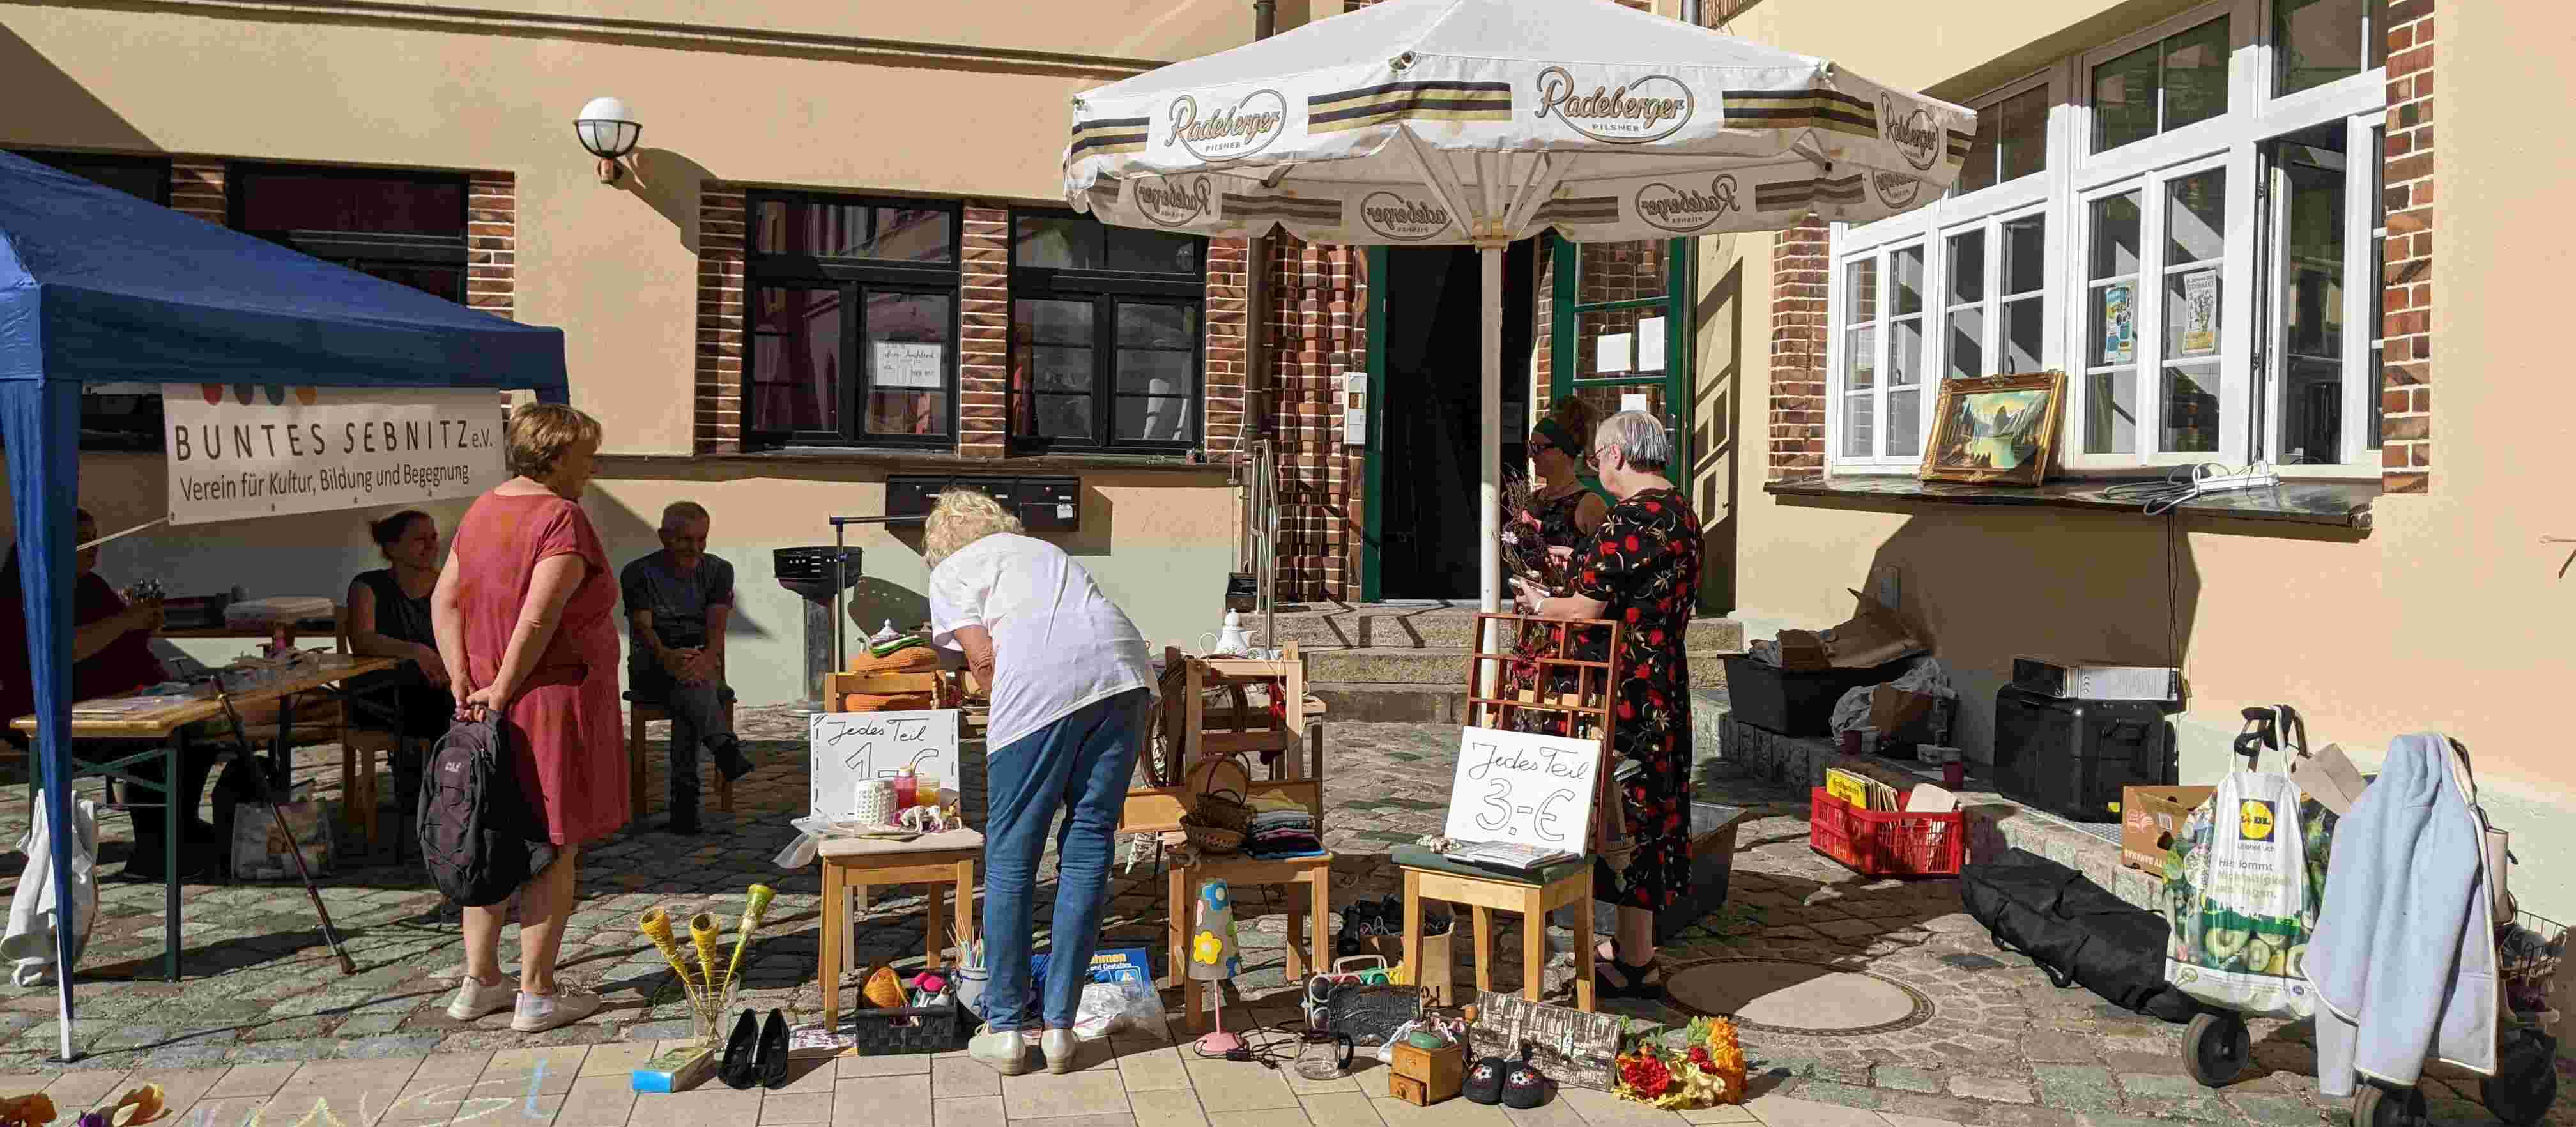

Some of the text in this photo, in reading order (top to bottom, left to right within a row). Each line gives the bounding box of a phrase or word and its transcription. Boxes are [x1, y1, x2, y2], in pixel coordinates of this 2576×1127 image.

[1535, 66, 1685, 130] Radeberger
[1165, 95, 1281, 146] Radeberger
[1591, 123, 1639, 132] PILSNER
[1206, 142, 1241, 152] PILSNER
[175, 420, 493, 461] BUNTES SEBNITZ e.V.
[180, 463, 470, 501] Verein für Kultur, Bildung und Begegnung
[827, 718, 930, 746] Jedes Teil
[1468, 742, 1590, 780] Jedes Teil
